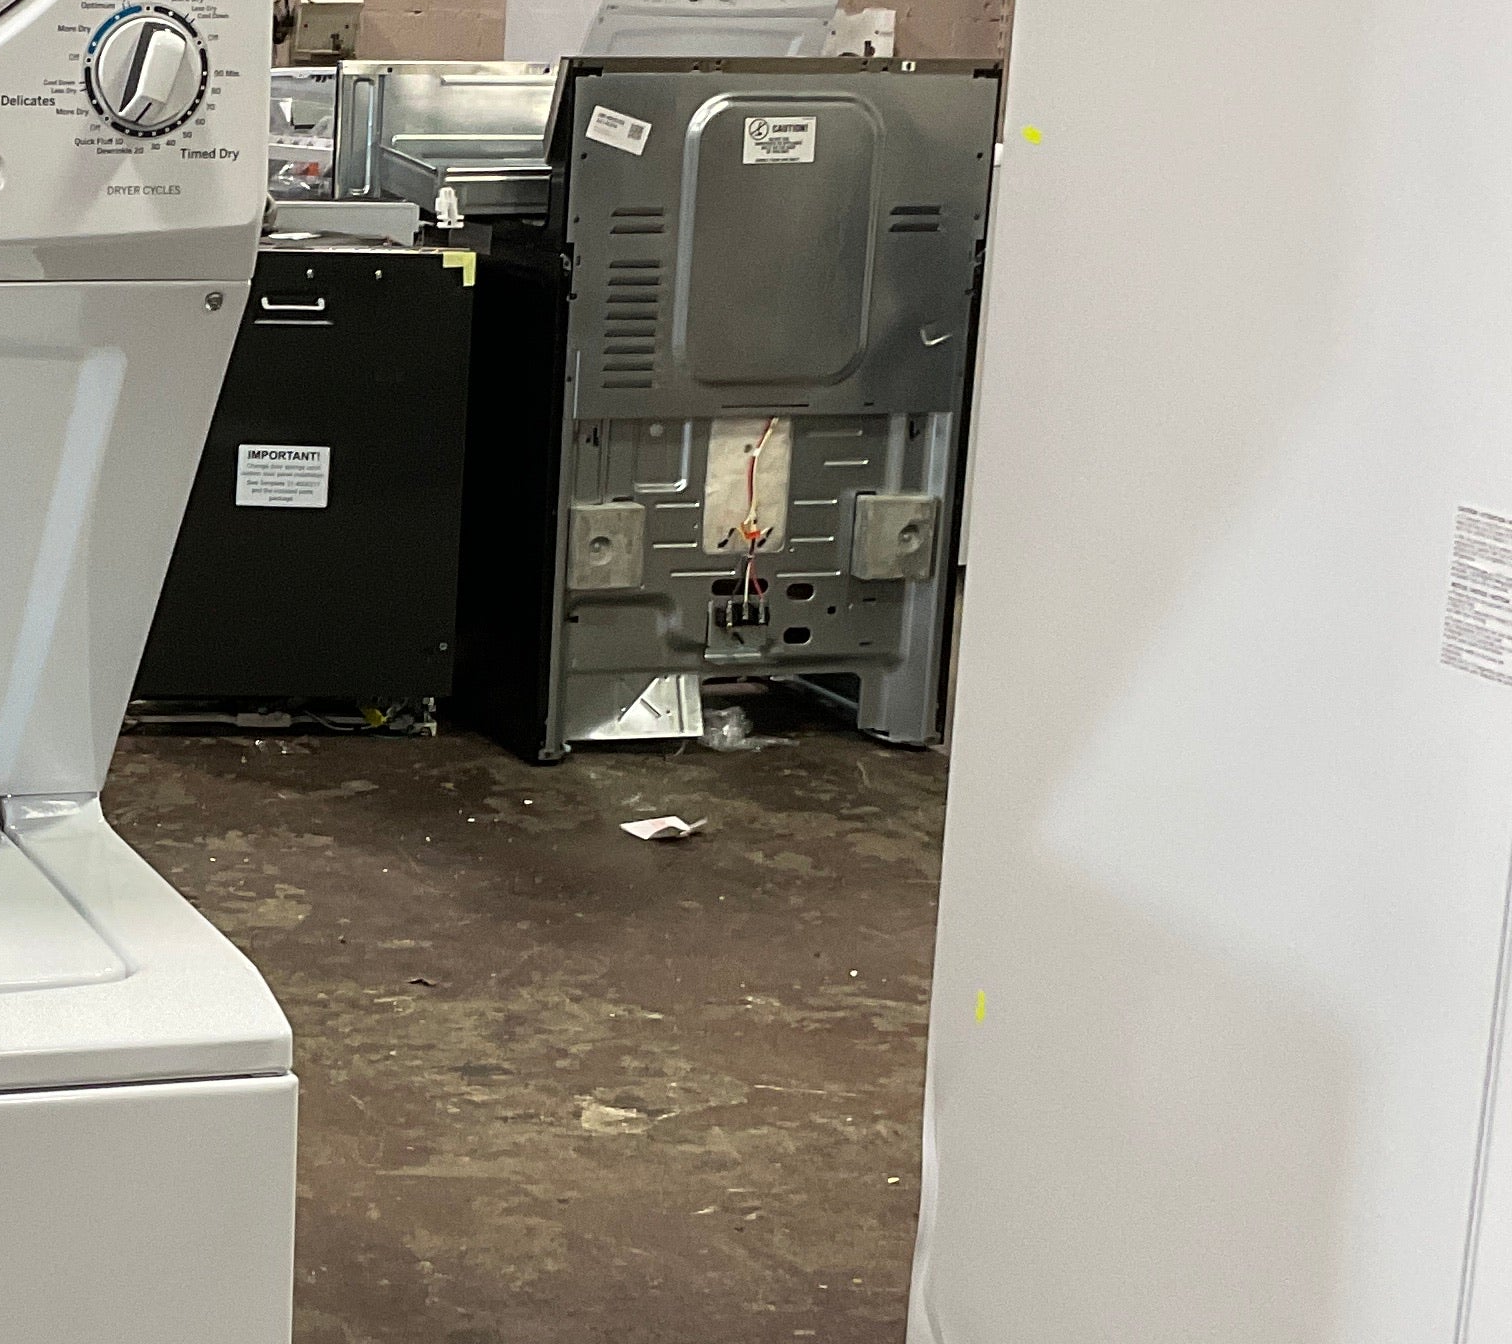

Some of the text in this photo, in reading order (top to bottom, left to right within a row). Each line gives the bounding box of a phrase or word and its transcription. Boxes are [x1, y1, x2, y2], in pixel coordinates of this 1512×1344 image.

[78, 24, 91, 34] Dry
[0, 95, 56, 107] Delicates
[76, 107, 89, 117] Dry
[195, 118, 206, 126] 60
[74, 137, 95, 147] Quick
[165, 139, 176, 147] 40
[180, 148, 240, 162] Timed Dry
[106, 185, 181, 196] DRYER CYCLES
[247, 450, 320, 462] IMPORTANT!
